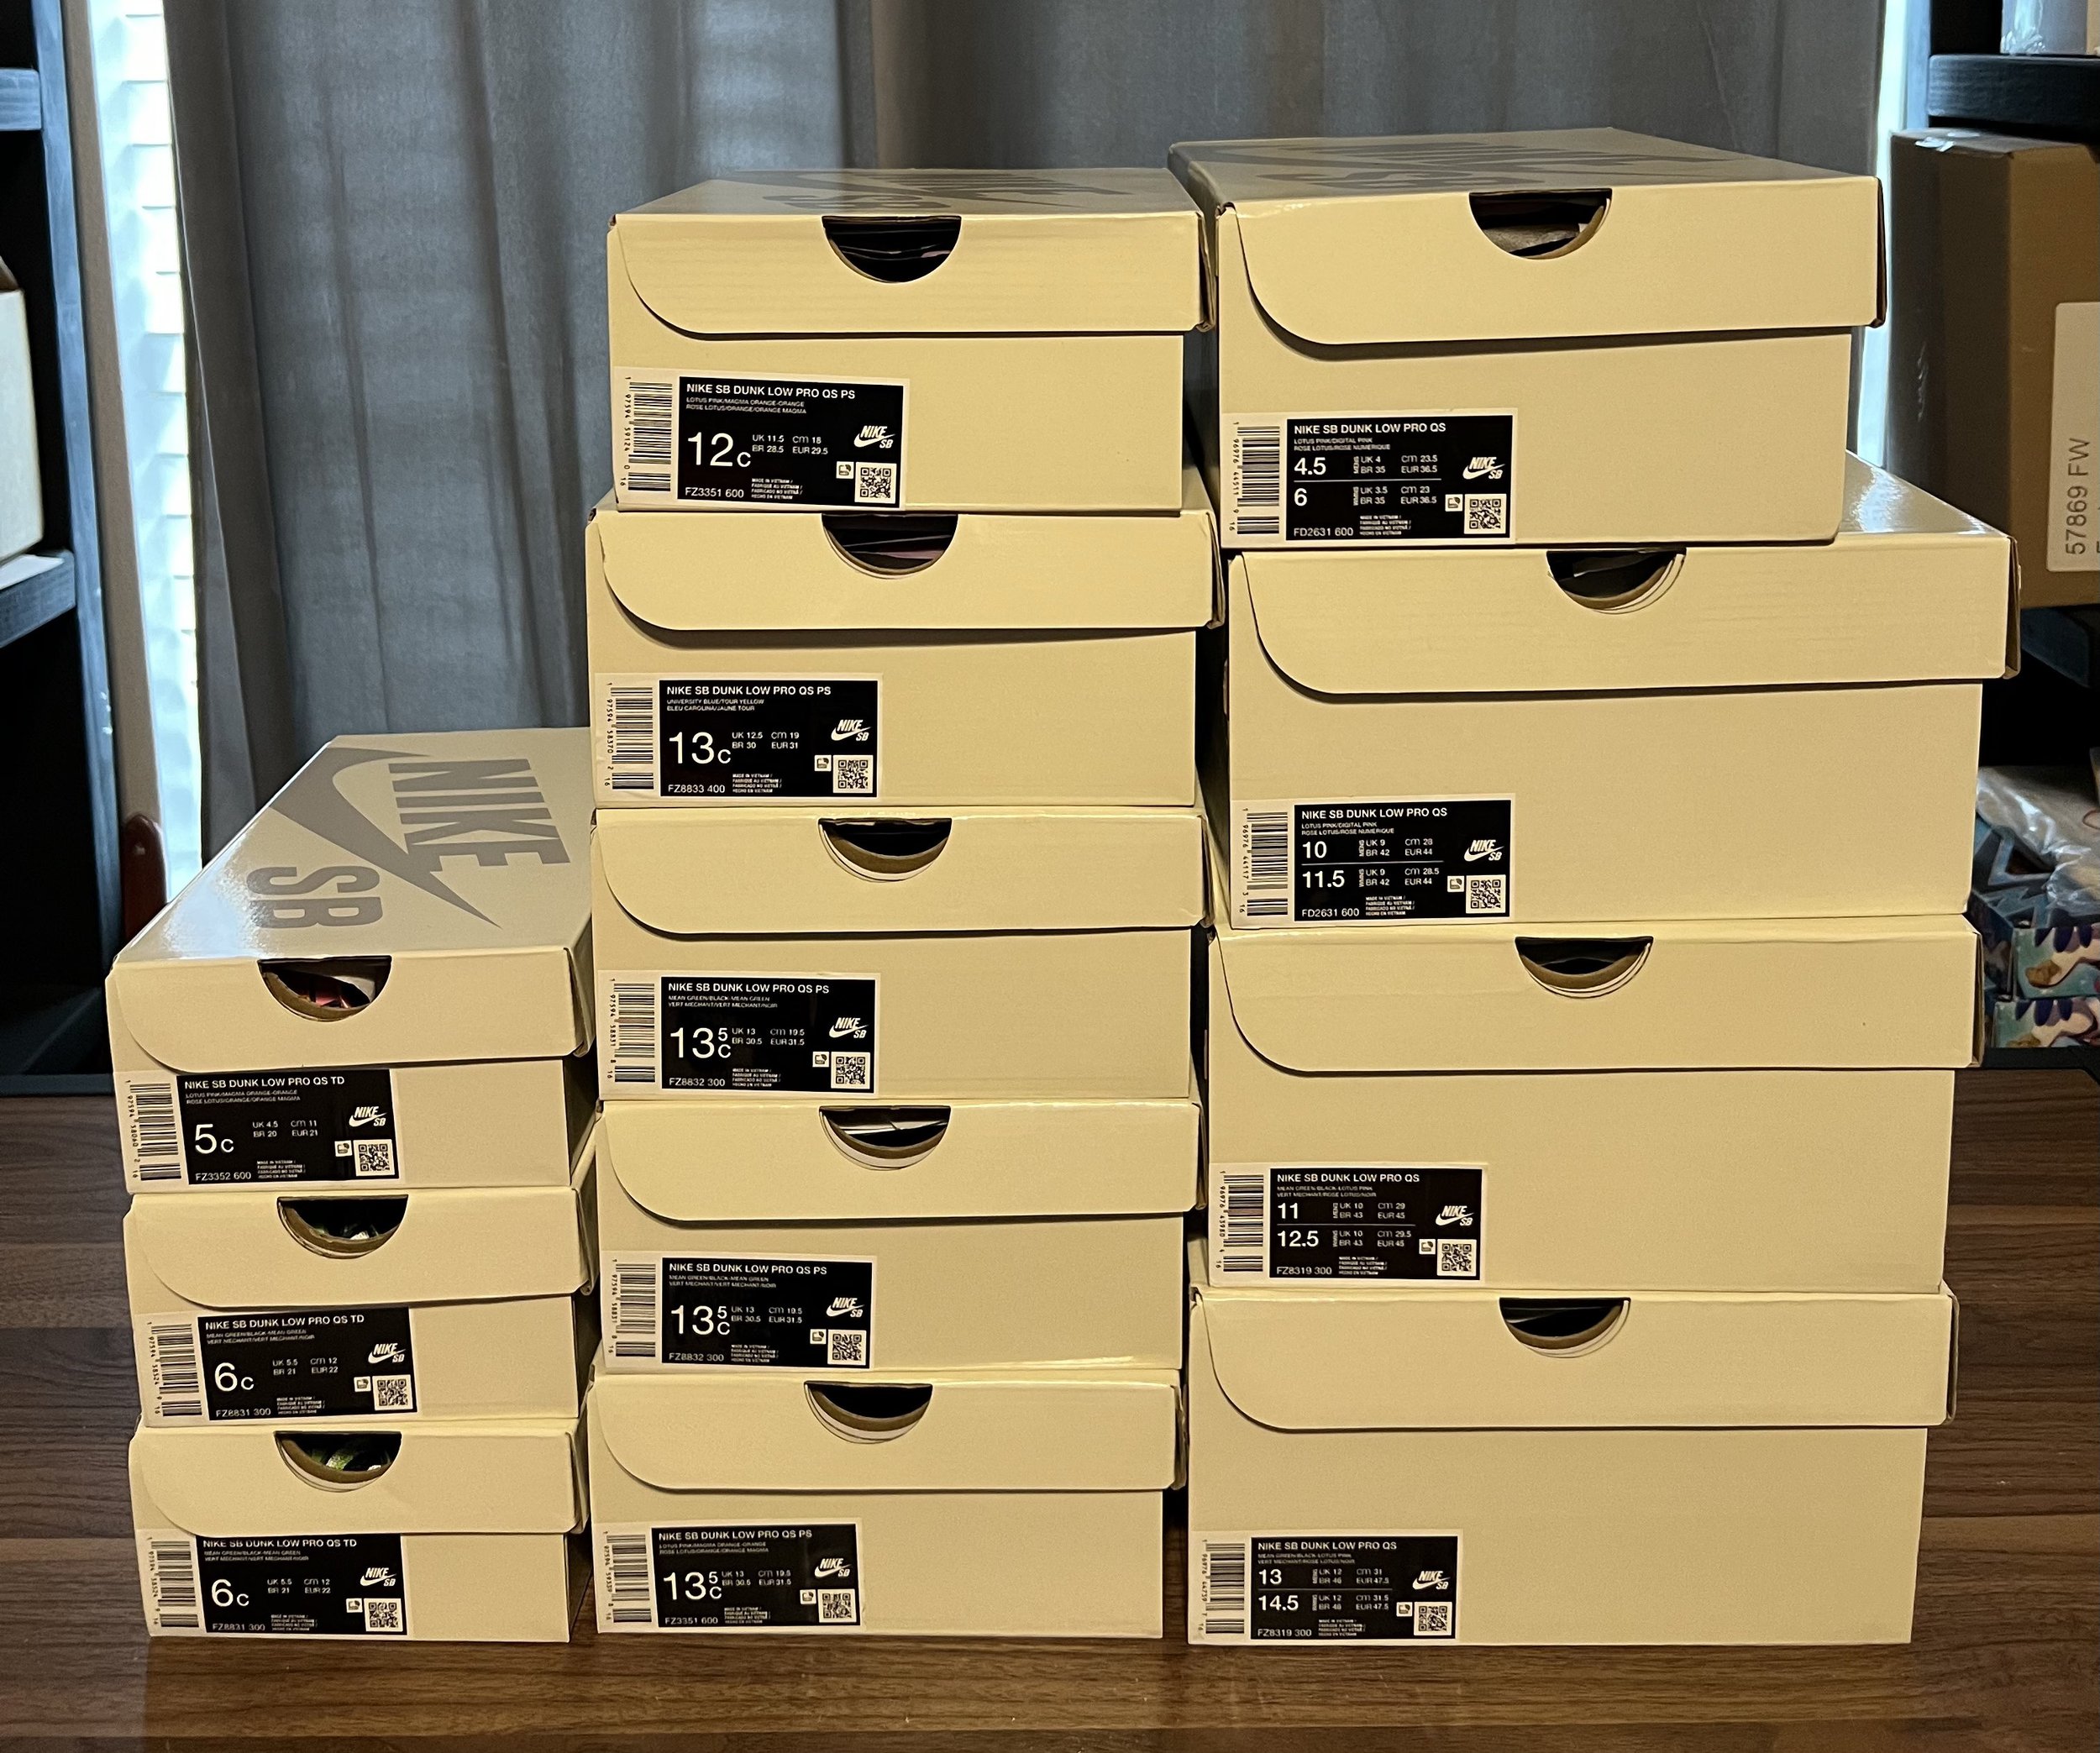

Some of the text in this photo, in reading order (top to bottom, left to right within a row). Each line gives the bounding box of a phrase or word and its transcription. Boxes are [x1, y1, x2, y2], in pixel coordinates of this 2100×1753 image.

[687, 384, 855, 399] NIKE SB DUNK LOW PRO QS PS
[860, 426, 887, 438] NIKE
[1294, 423, 1446, 433] NIKE SB DUNK LOW PRO QS
[879, 439, 893, 449] SB
[1294, 457, 1326, 475] 4.5
[1469, 457, 1497, 469] NIKE
[1488, 469, 1503, 480] SB
[685, 487, 721, 496] FZ3351
[726, 489, 743, 498] 600
[1294, 488, 1307, 506] 6
[2066, 438, 2091, 555] 57869 FW
[1294, 527, 1353, 536] FD2631 600
[667, 686, 831, 695] NIKE SB DUNK LOW PRO QS PS
[669, 785, 725, 793] FZ8833 400
[388, 758, 570, 872] NIKE
[1302, 808, 1447, 819] NIKE SB DUNK LOW PRO QS
[1303, 841, 1326, 858] 10
[1303, 870, 1345, 888] 11.5
[247, 866, 384, 929] SB
[1302, 908, 1359, 917] FD2631 600
[669, 983, 692, 991] NIKE
[773, 984, 795, 993] PRO
[798, 984, 812, 993] QS
[816, 985, 829, 994] PS
[313, 1077, 328, 1085] QS
[669, 1078, 704, 1086] FZ8832
[196, 1173, 230, 1181] FZ3352
[1305, 1173, 1318, 1182] SB
[1321, 1173, 1350, 1182] DUNK
[1278, 1203, 1297, 1219] 11
[1278, 1231, 1319, 1247] 12.5
[796, 1266, 811, 1274] QS
[206, 1321, 229, 1330] NIKE
[249, 1319, 279, 1327] DUNK
[282, 1318, 305, 1326] LOW
[308, 1316, 330, 1325] PRO
[333, 1315, 348, 1324] QS
[669, 1352, 704, 1361] FZ8832
[1259, 1569, 1282, 1584] 13
[1258, 1595, 1299, 1610] 14.5
